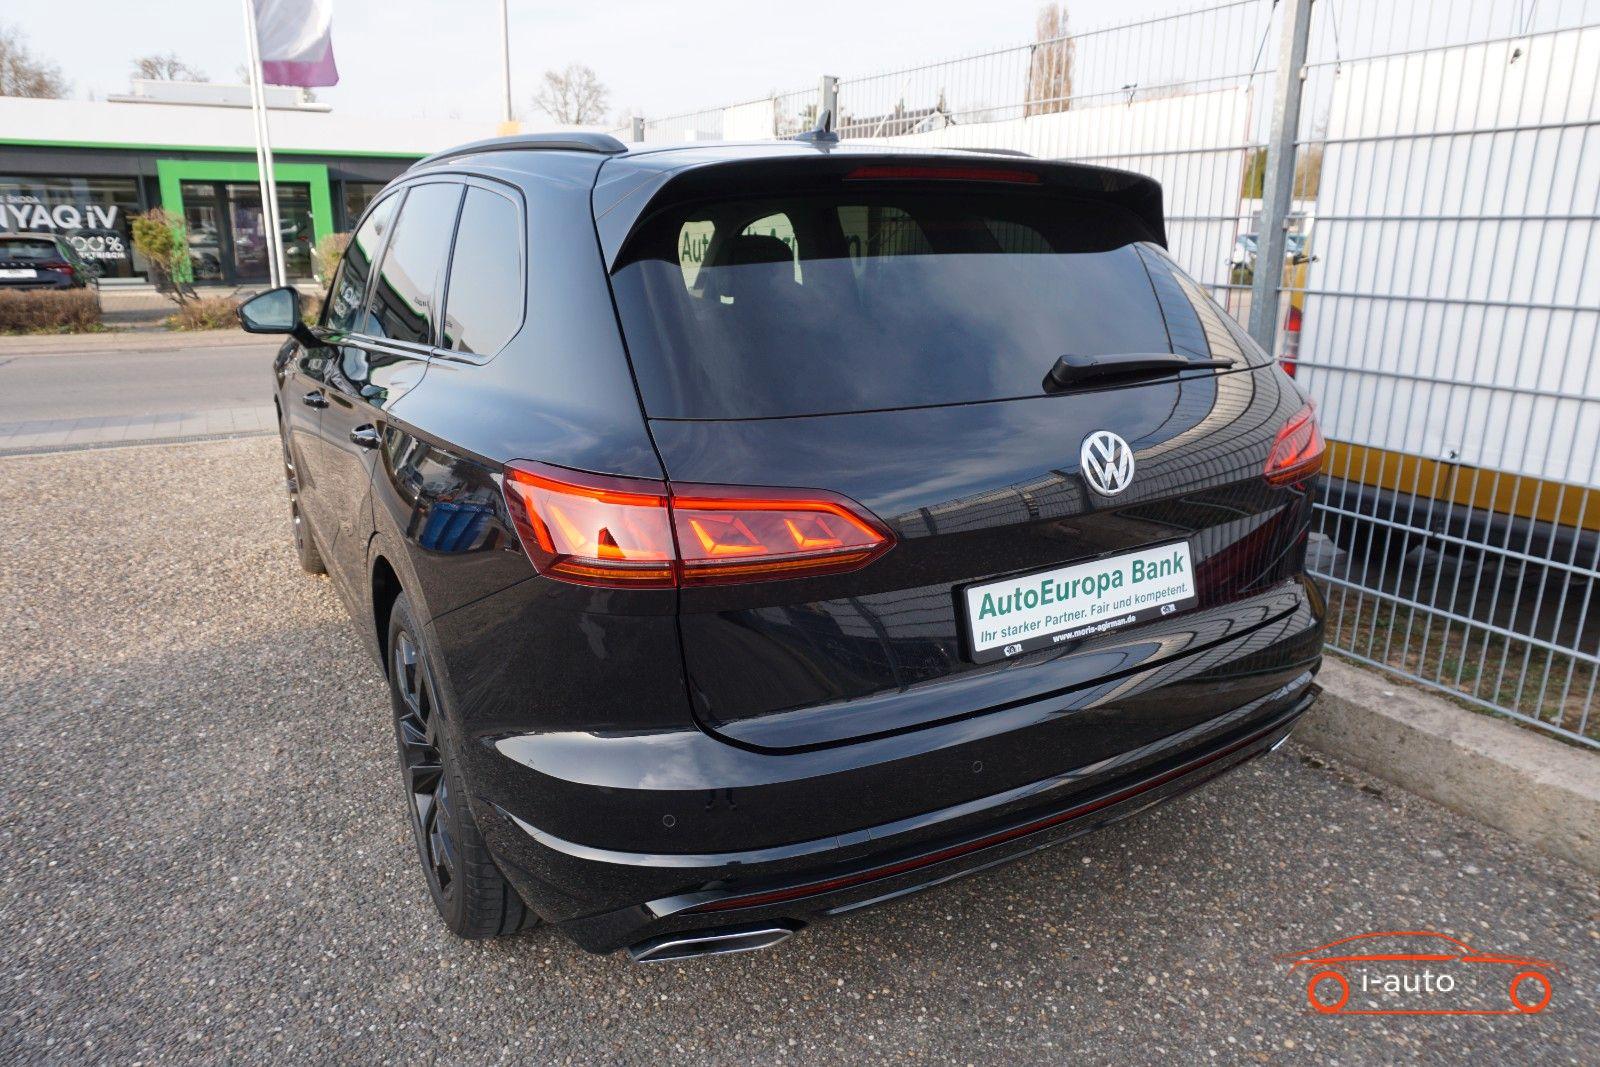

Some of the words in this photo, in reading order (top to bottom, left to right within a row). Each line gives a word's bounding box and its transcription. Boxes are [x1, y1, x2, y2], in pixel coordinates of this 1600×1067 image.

[85, 205, 118, 229] iV
[978, 568, 1124, 620] AutoEuropa
[1132, 551, 1184, 584] Bank
[981, 629, 998, 643] Ihr
[1001, 618, 1041, 638] starker
[1045, 608, 1087, 627] Partner.
[1091, 601, 1110, 616] Fair
[1113, 595, 1132, 610] und
[1134, 582, 1188, 605] kompetent.
[1053, 614, 1137, 642] www.moris-agirman.de
